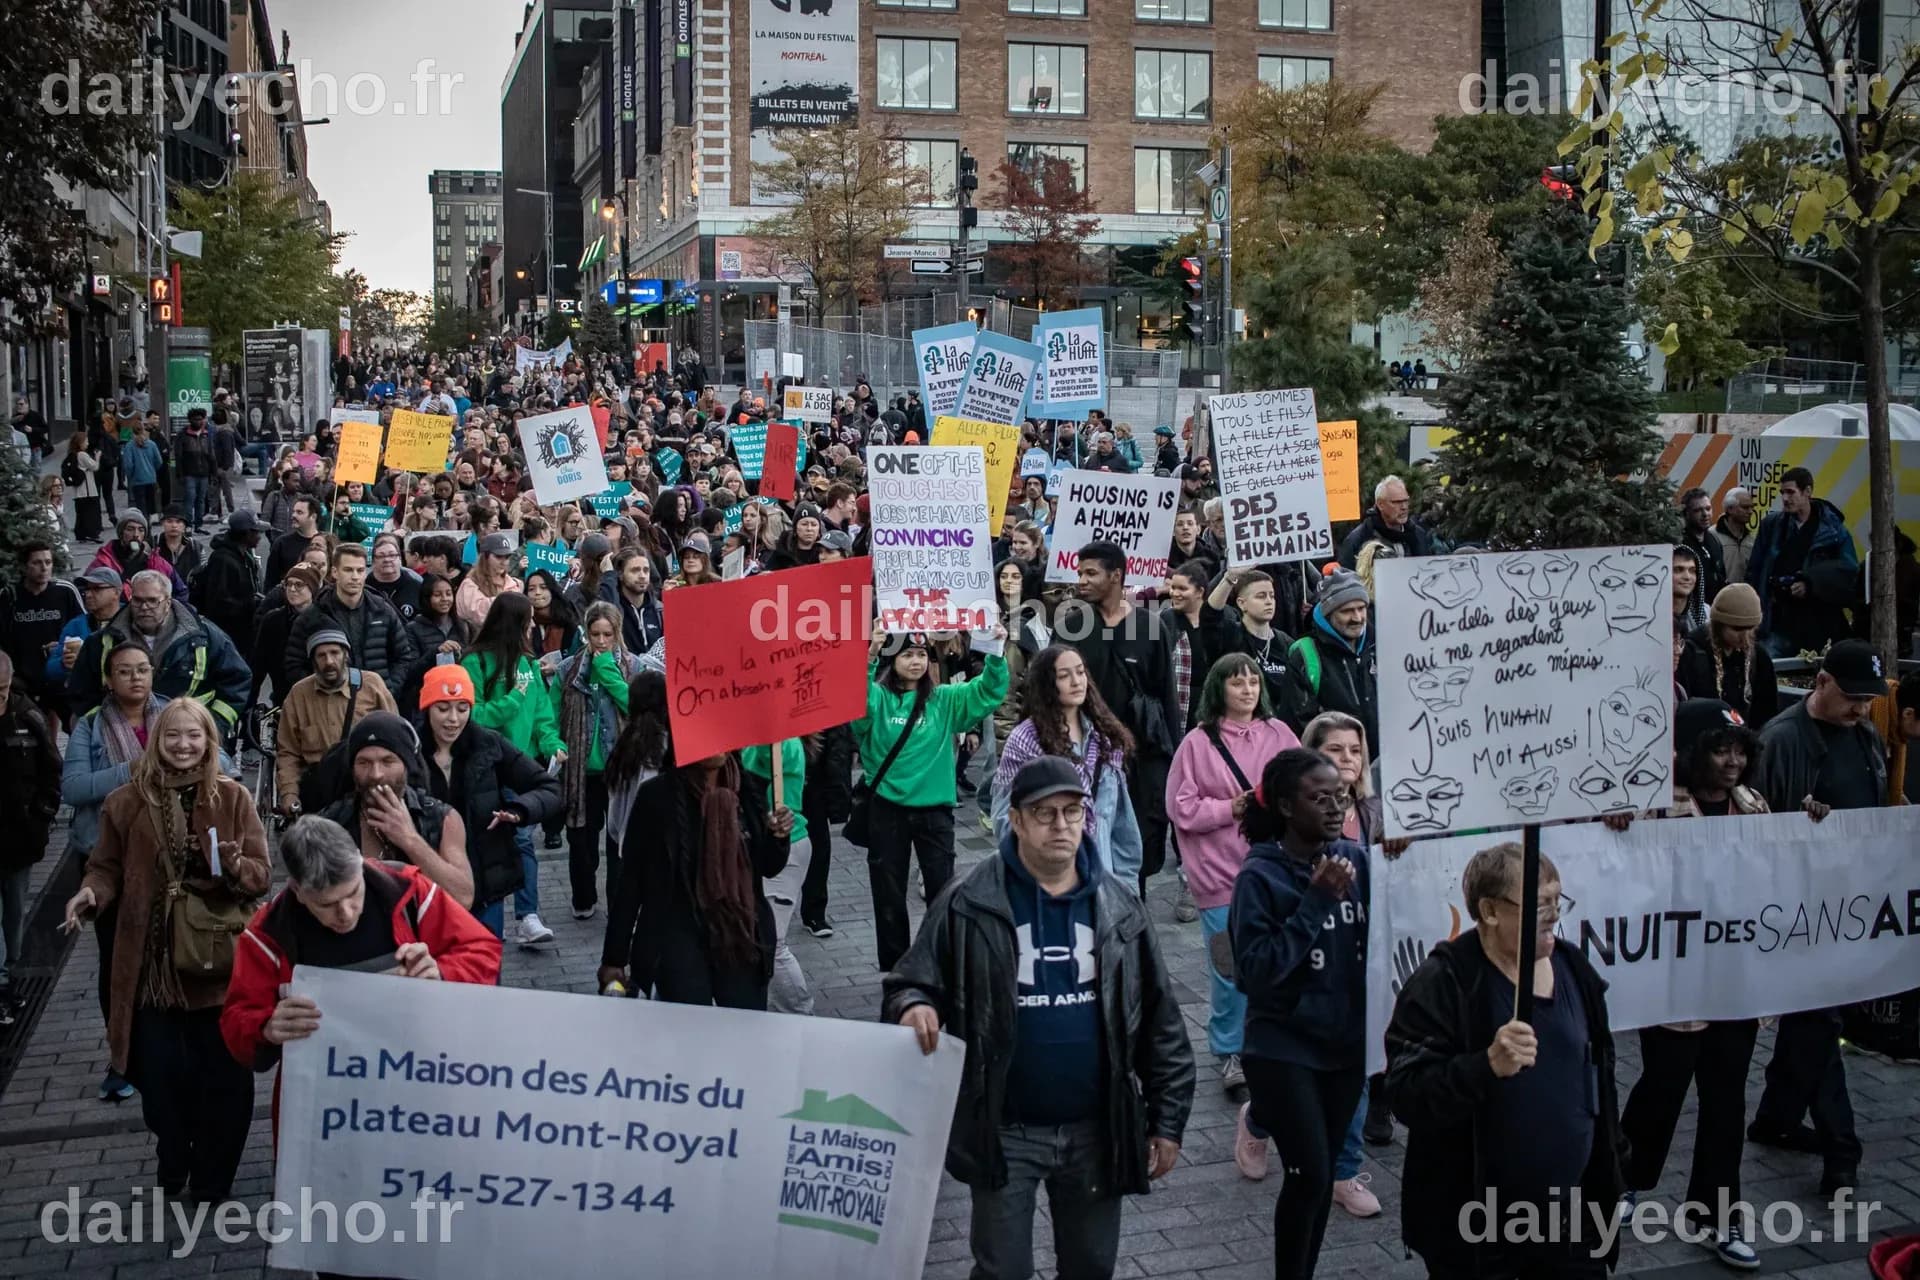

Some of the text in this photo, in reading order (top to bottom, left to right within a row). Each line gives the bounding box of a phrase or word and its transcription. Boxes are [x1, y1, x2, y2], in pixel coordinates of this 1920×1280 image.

[768, 32, 801, 40] MAISON
[817, 33, 856, 42] FESTIVAL
[624, 73, 632, 108] STUDIO
[758, 99, 848, 110] BILLETS EN VENTE
[769, 112, 840, 124] MAINTENANT!
[1049, 365, 1098, 378] LUTTE
[804, 392, 831, 402] LE SAC
[814, 402, 831, 410] DOS
[967, 385, 1020, 408] LUTTE
[970, 398, 994, 408] POUR
[1212, 390, 1307, 412] NOUS SOMMES
[957, 421, 988, 436] ALLER
[994, 425, 1018, 440] PLUS
[1216, 414, 1254, 430] TOUS
[1259, 410, 1274, 424] LE
[1219, 432, 1238, 446] LA
[1740, 438, 1760, 459] UN
[874, 452, 980, 477] ONE OF THE
[1222, 467, 1236, 480] LE
[556, 472, 582, 485] DORIS
[873, 478, 984, 500] TOUGHEST
[1224, 482, 1240, 495] DE
[598, 496, 612, 504] EST
[1070, 482, 1175, 510] HOUSING IS
[1230, 492, 1278, 520] DES
[596, 508, 616, 516] TOUT
[874, 504, 988, 524] JOBS WE HAVE IS
[1074, 508, 1150, 530] A HUMAN
[874, 528, 974, 548] CONVINCING
[1092, 528, 1144, 550] RIGHT
[1236, 529, 1331, 562] HUMAINS
[536, 549, 546, 560] LE
[1056, 550, 1168, 578] NO ROMISE
[878, 568, 990, 590] NOT MAKING UP
[903, 588, 950, 608] THIS
[1418, 597, 1597, 641] Au-delà des yeux
[1404, 624, 1564, 674] qui me regardent
[674, 655, 725, 686] Mme
[740, 646, 757, 671] la
[1494, 662, 1537, 685] avec
[676, 686, 715, 716] On
[720, 687, 729, 700] a
[1580, 910, 1702, 966] NUIT
[1704, 919, 1756, 944] DES
[1758, 894, 1871, 953] SANS
[1018, 990, 1096, 1007] DER ARMO
[327, 1046, 745, 1110] La Maison des Amis du
[322, 1098, 739, 1164] plateau Mont-Royal
[790, 1124, 897, 1156] La Maison
[795, 1147, 882, 1176] Amis
[784, 1166, 890, 1193] PLATEAU
[380, 1168, 676, 1214] 514-527-1344
[780, 1180, 883, 1227] MONT-ROYAL
